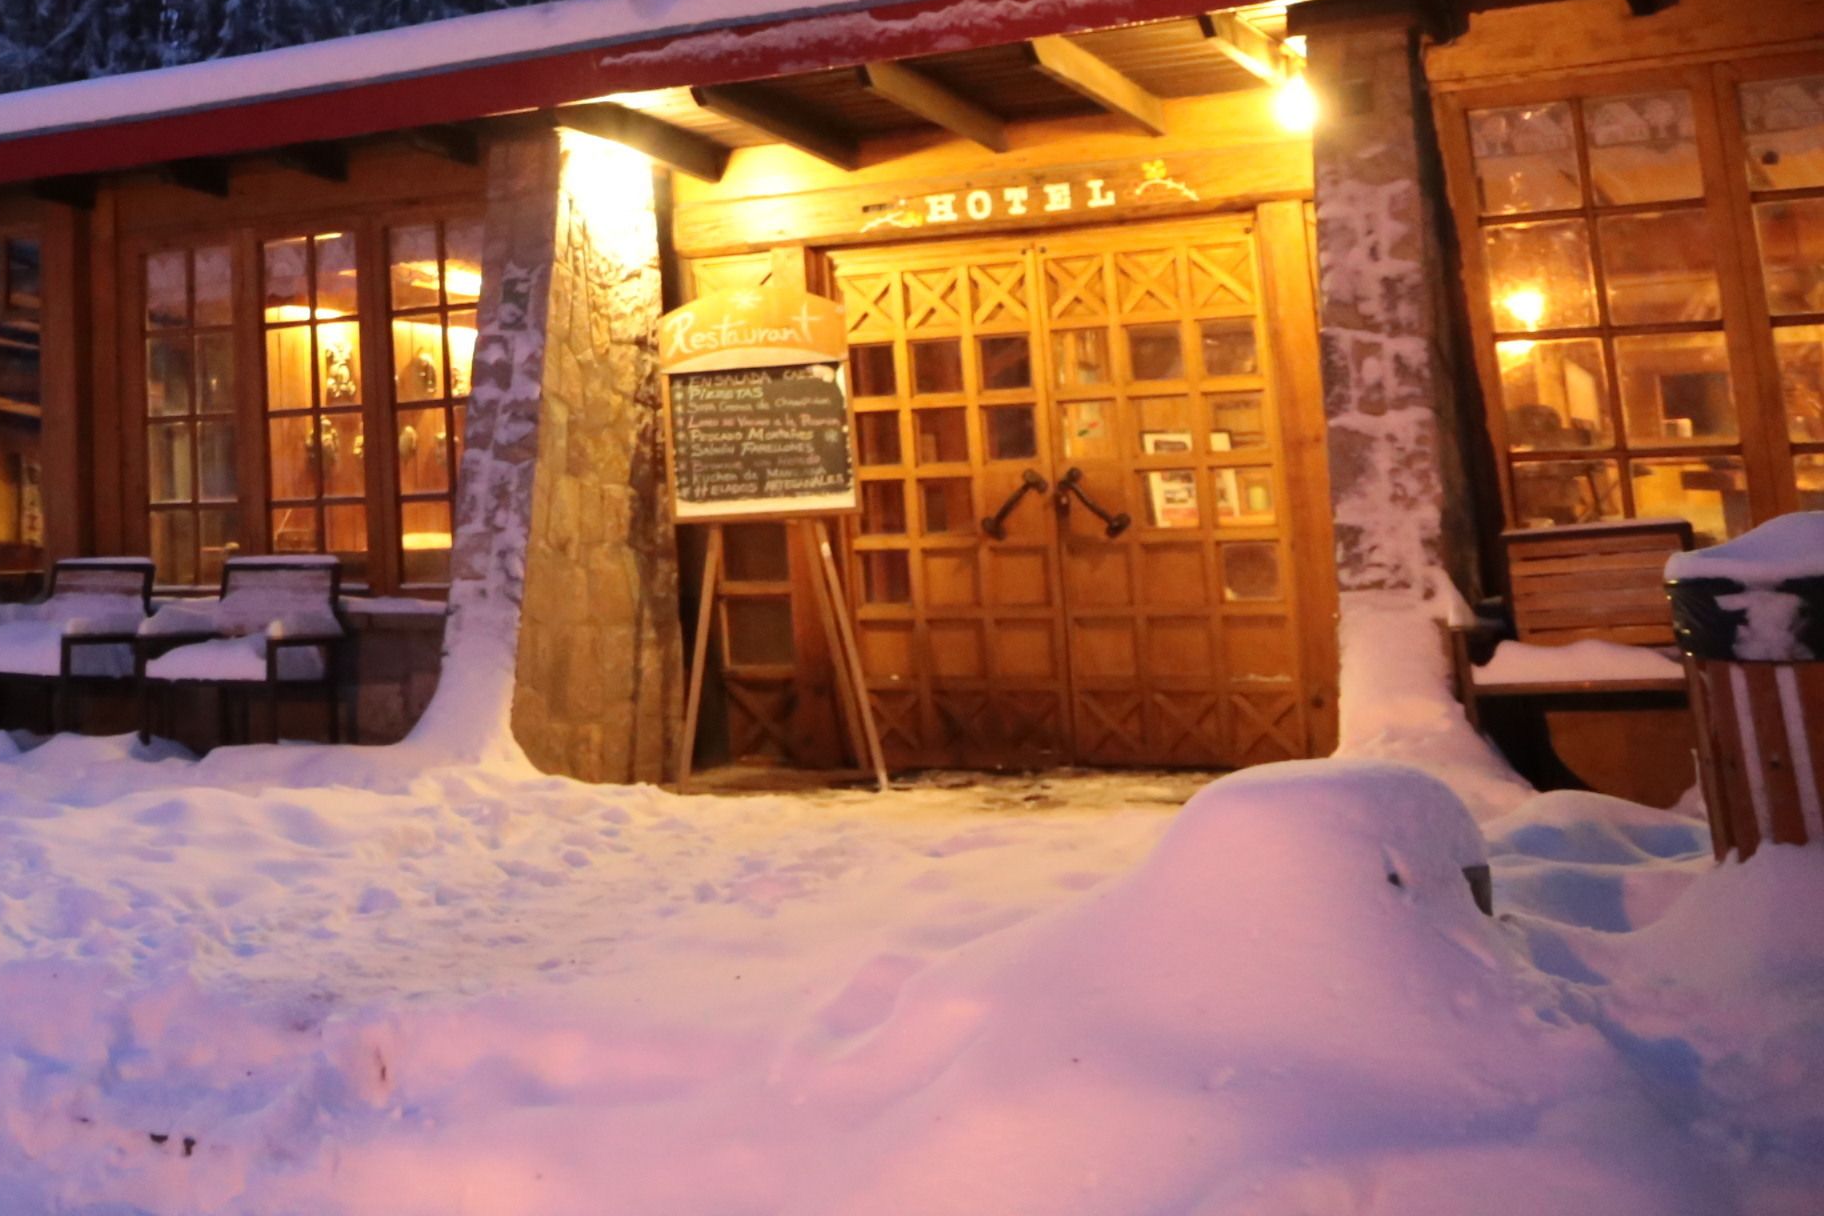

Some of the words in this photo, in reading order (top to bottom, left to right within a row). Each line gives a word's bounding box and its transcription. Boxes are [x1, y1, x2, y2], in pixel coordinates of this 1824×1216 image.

[924, 178, 1116, 224] HOTEL
[663, 301, 824, 359] Restaurant
[688, 371, 773, 388] ENSALADA
